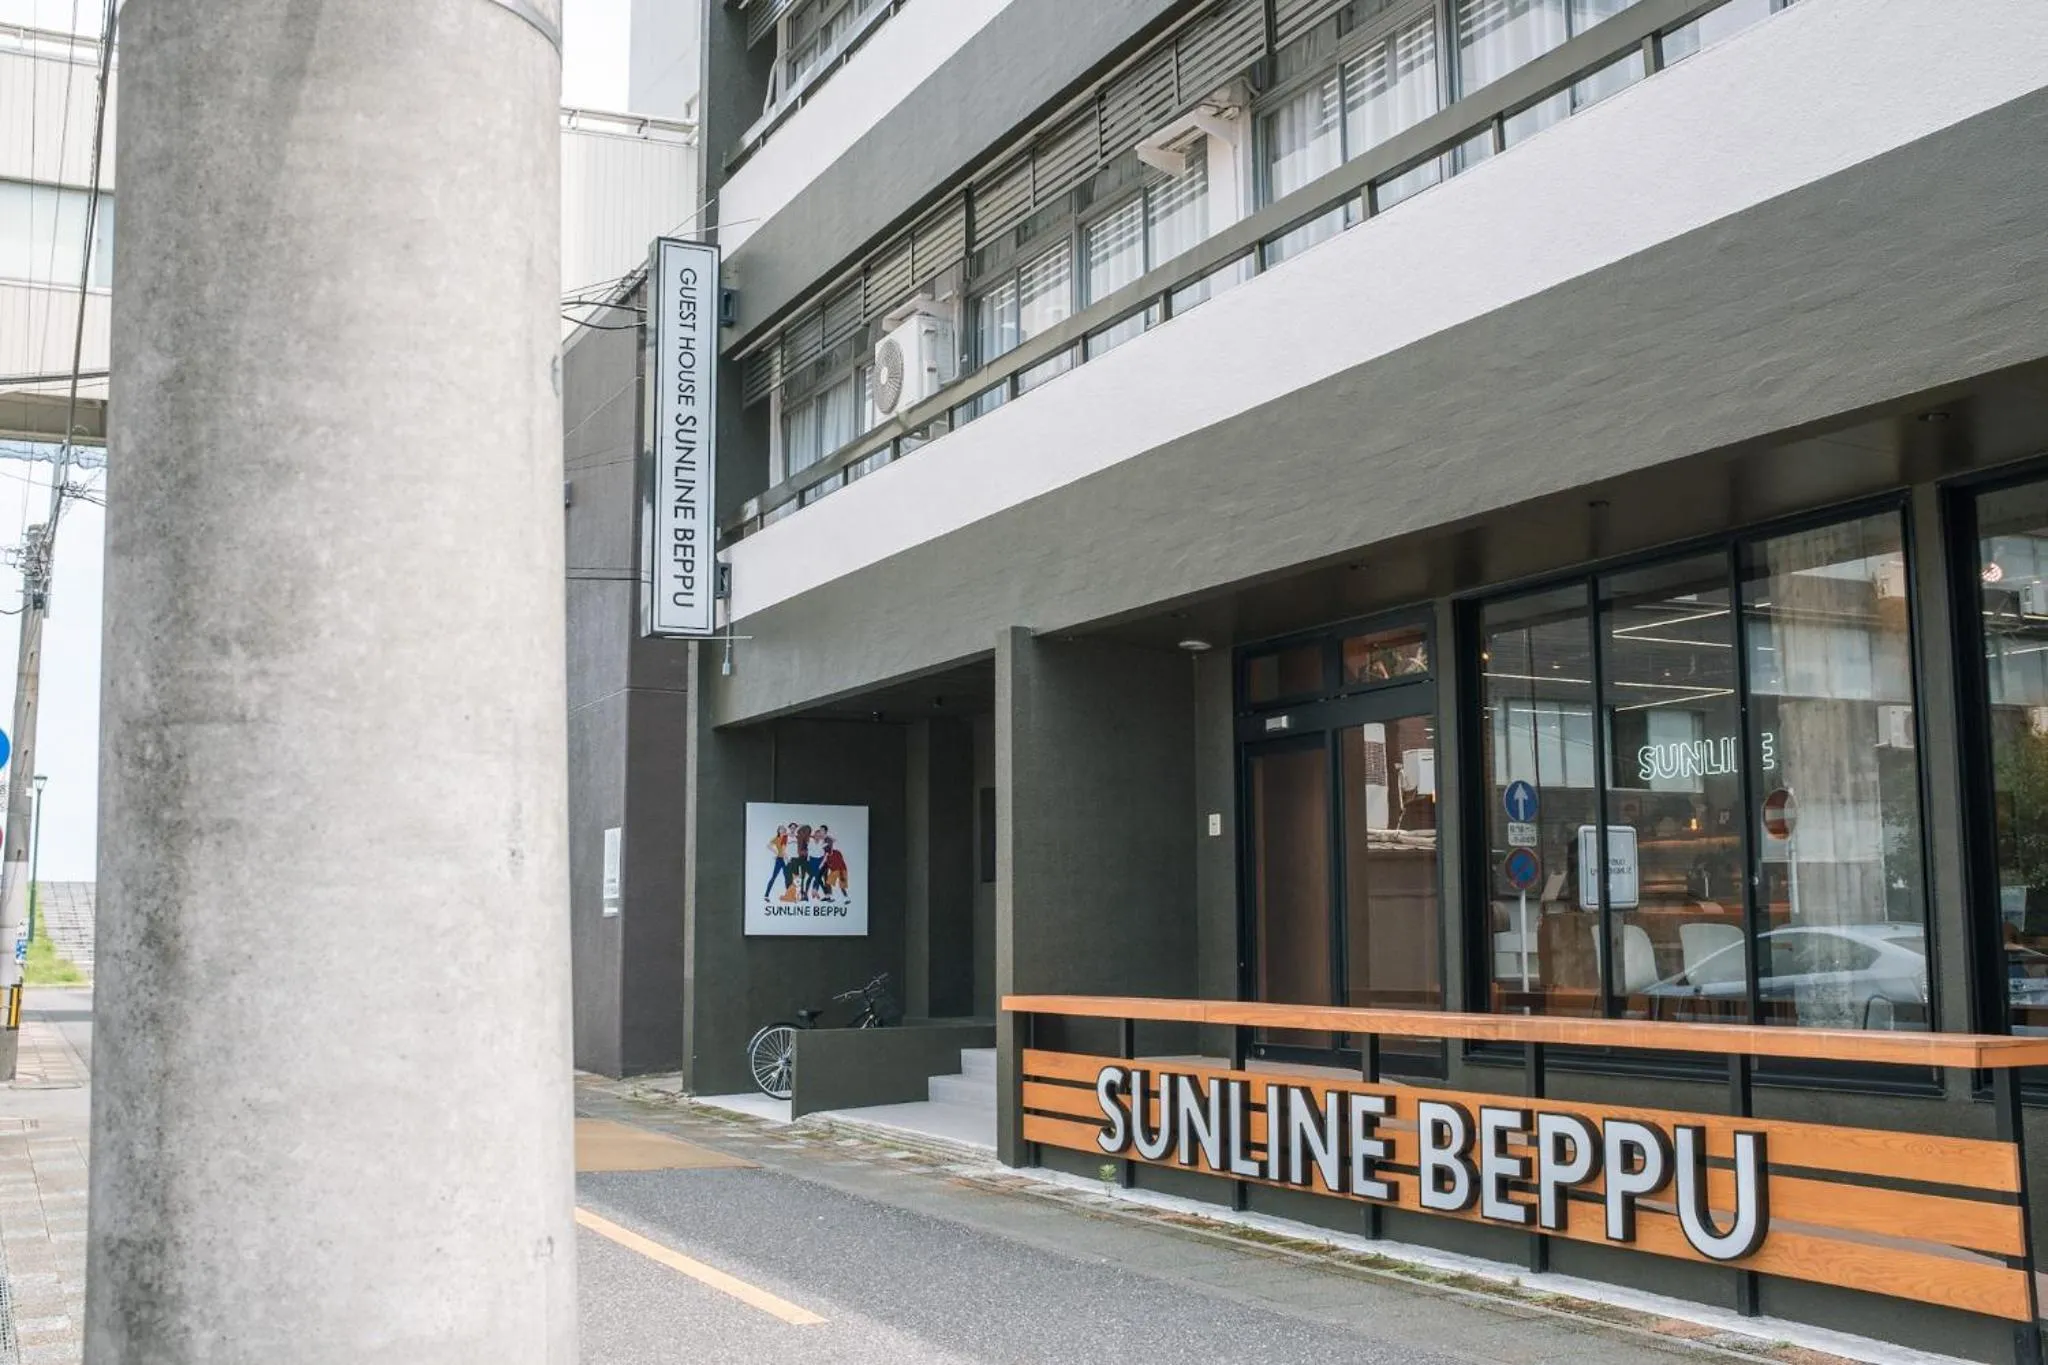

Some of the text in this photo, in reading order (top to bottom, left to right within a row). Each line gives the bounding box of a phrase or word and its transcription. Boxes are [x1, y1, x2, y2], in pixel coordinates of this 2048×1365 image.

[672, 267, 698, 609] GUEST HOUSE SUNLINE BEPPU
[1637, 732, 1776, 781] SUNLIE
[764, 905, 848, 918] SUNLINE BEPPU
[1096, 1065, 1770, 1261] SUNLINE BEPPU
